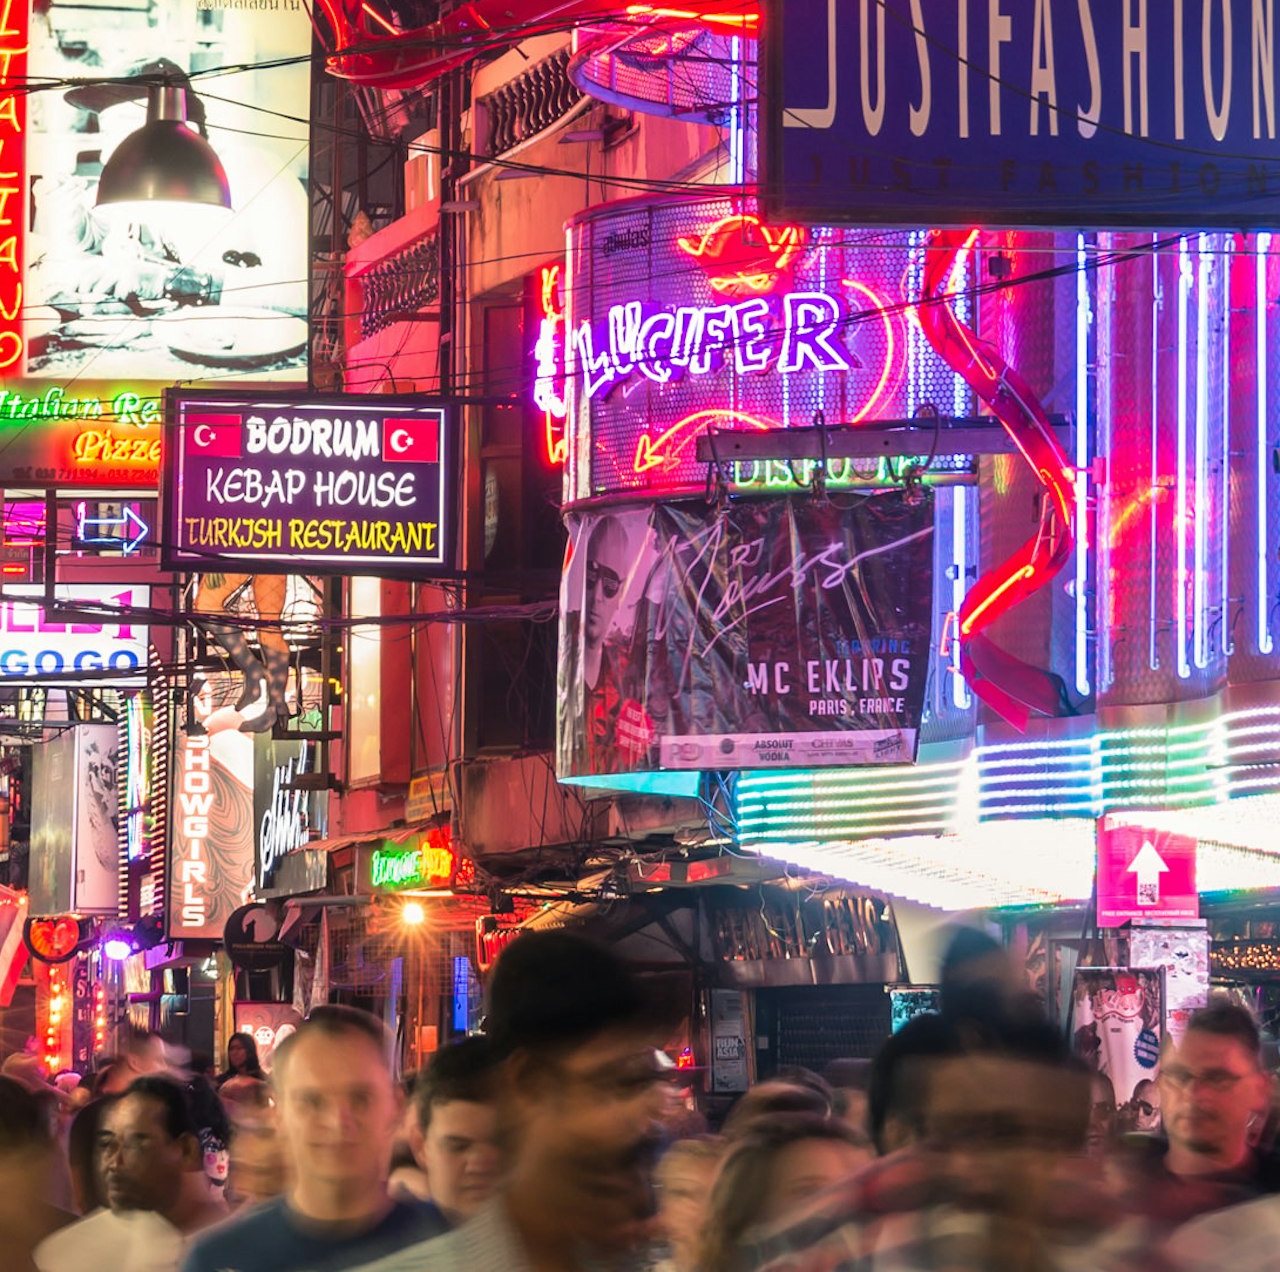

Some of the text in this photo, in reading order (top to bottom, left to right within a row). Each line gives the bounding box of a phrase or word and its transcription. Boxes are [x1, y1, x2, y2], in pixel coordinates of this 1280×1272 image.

[575, 291, 850, 399] LUCIFER
[114, 392, 162, 428] Re
[246, 415, 380, 461] BODRUM
[206, 467, 417, 508] KEBAP HOUSE
[289, 518, 437, 554] RESTAURANT
[747, 661, 791, 695] MC
